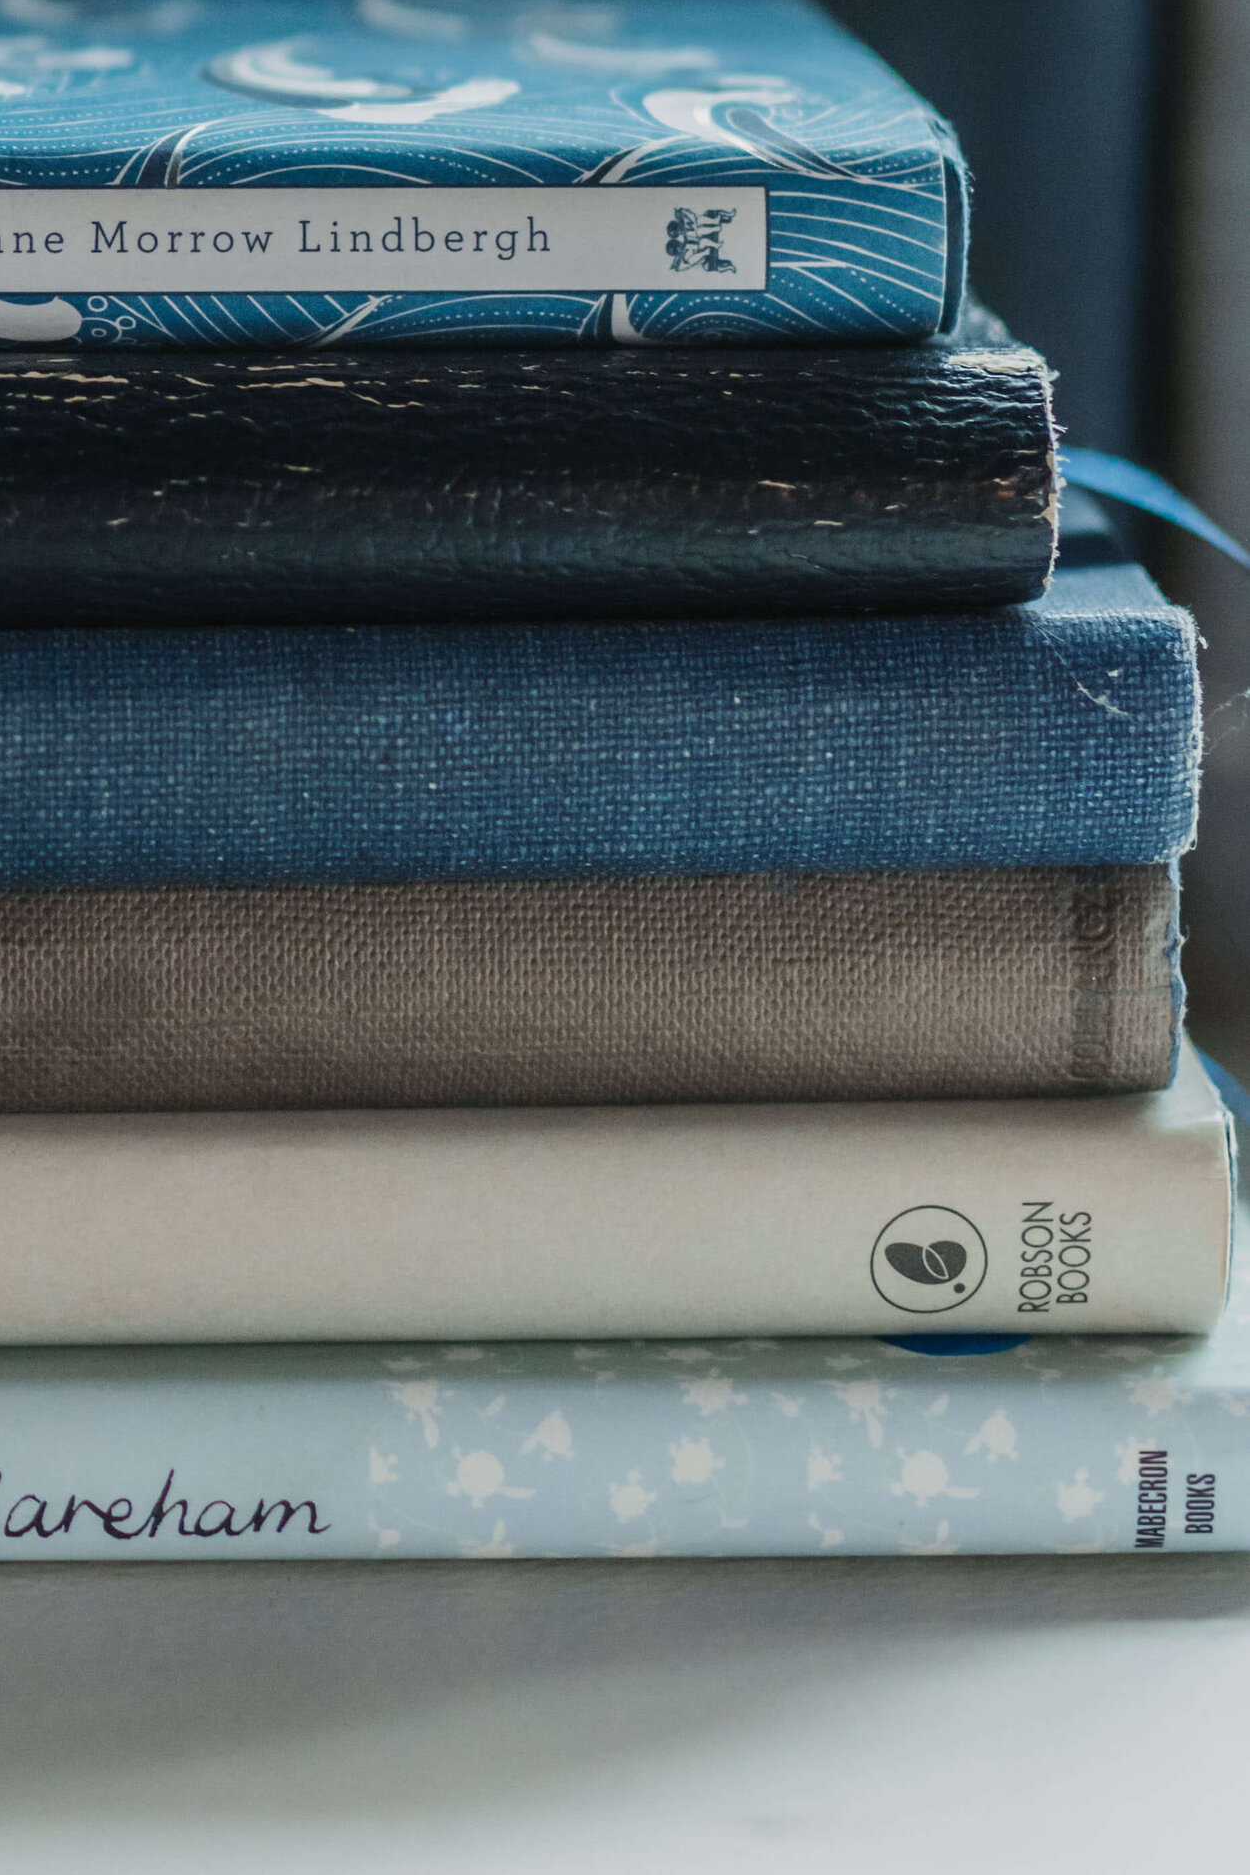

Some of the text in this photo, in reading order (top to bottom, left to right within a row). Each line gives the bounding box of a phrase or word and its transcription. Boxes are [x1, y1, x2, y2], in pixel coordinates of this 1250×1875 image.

[90, 220, 274, 255] Morrow
[298, 215, 552, 262] Lindbergh
[1016, 1201, 1054, 1314] ROBSON
[1055, 1211, 1093, 1305] BOOKS
[1133, 1450, 1169, 1550] MABECRON
[1184, 1473, 1217, 1535] BOOKS
